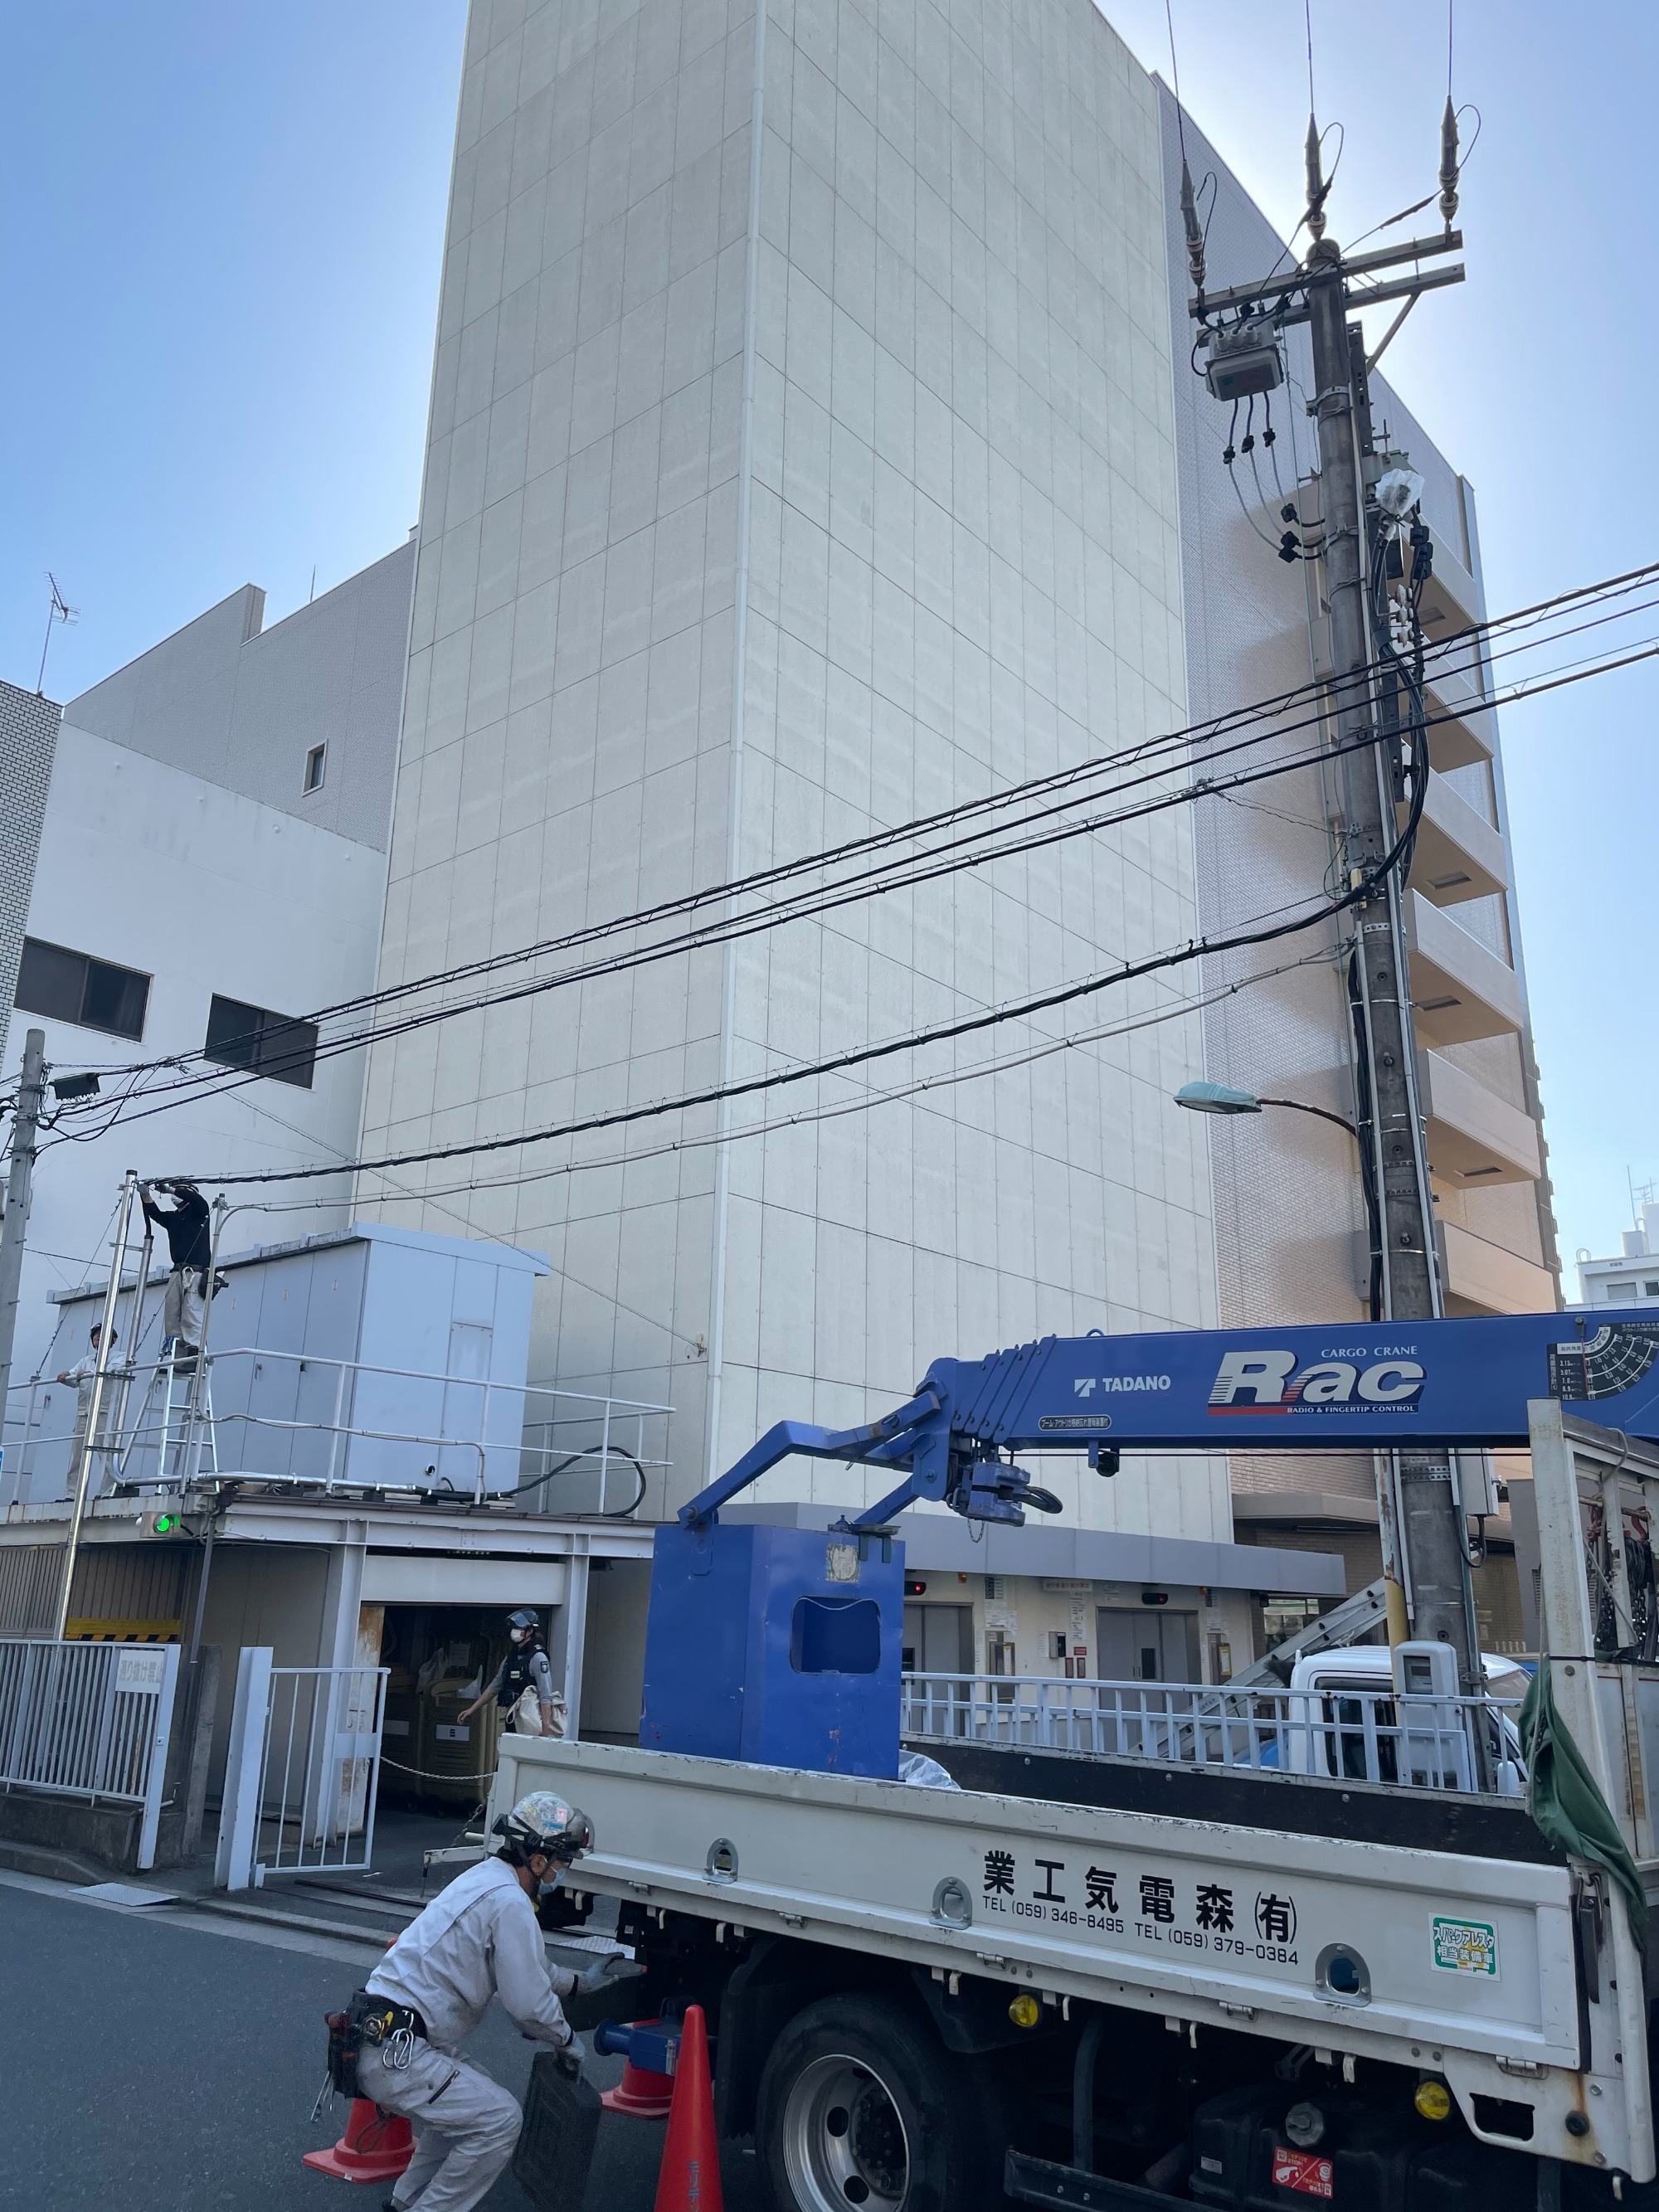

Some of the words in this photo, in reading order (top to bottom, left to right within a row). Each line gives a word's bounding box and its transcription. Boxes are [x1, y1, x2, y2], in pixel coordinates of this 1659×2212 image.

[1321, 1348, 1367, 1359] CARGO
[1374, 1345, 1418, 1356] CRANE
[1102, 1375, 1171, 1392] TADANO
[1208, 1350, 1427, 1403] Rac
[982, 1896, 1006, 1913] TEL
[1012, 1901, 1047, 1919] (059)
[1051, 1908, 1124, 1933] 346-8495
[1135, 1923, 1162, 1941] TEL
[1169, 1928, 1209, 1949] (059)
[1214, 1937, 1298, 1966] 379-0384
[1433, 1926, 1495, 1949] スパークアレスタ
[1437, 1944, 1494, 1965] 相当装備車
